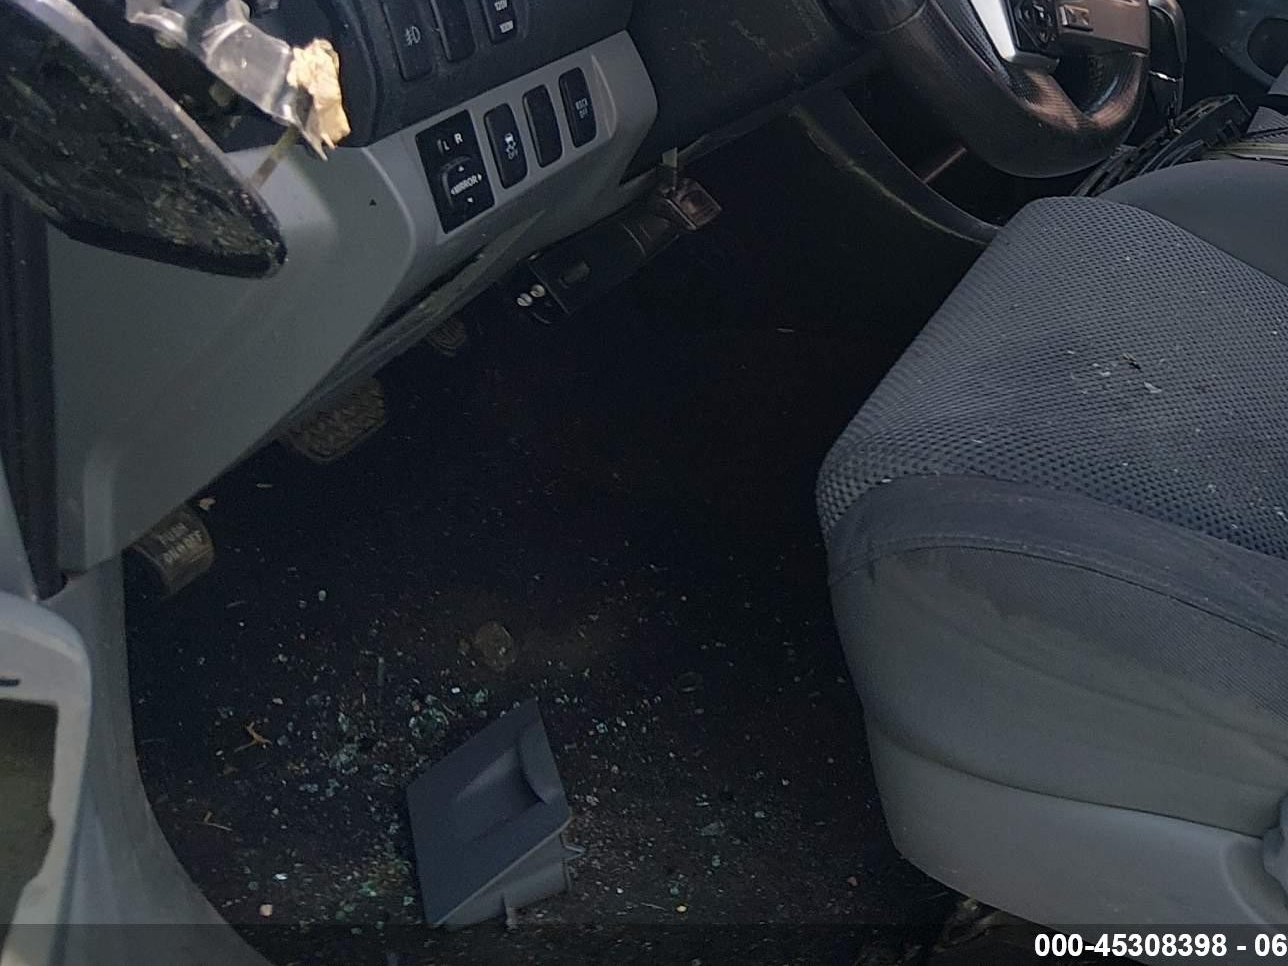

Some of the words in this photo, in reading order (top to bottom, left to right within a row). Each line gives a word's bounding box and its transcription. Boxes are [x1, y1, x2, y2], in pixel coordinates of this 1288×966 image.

[443, 140, 450, 151] L
[454, 133, 463, 144] R
[453, 175, 478, 194] MIRROR
